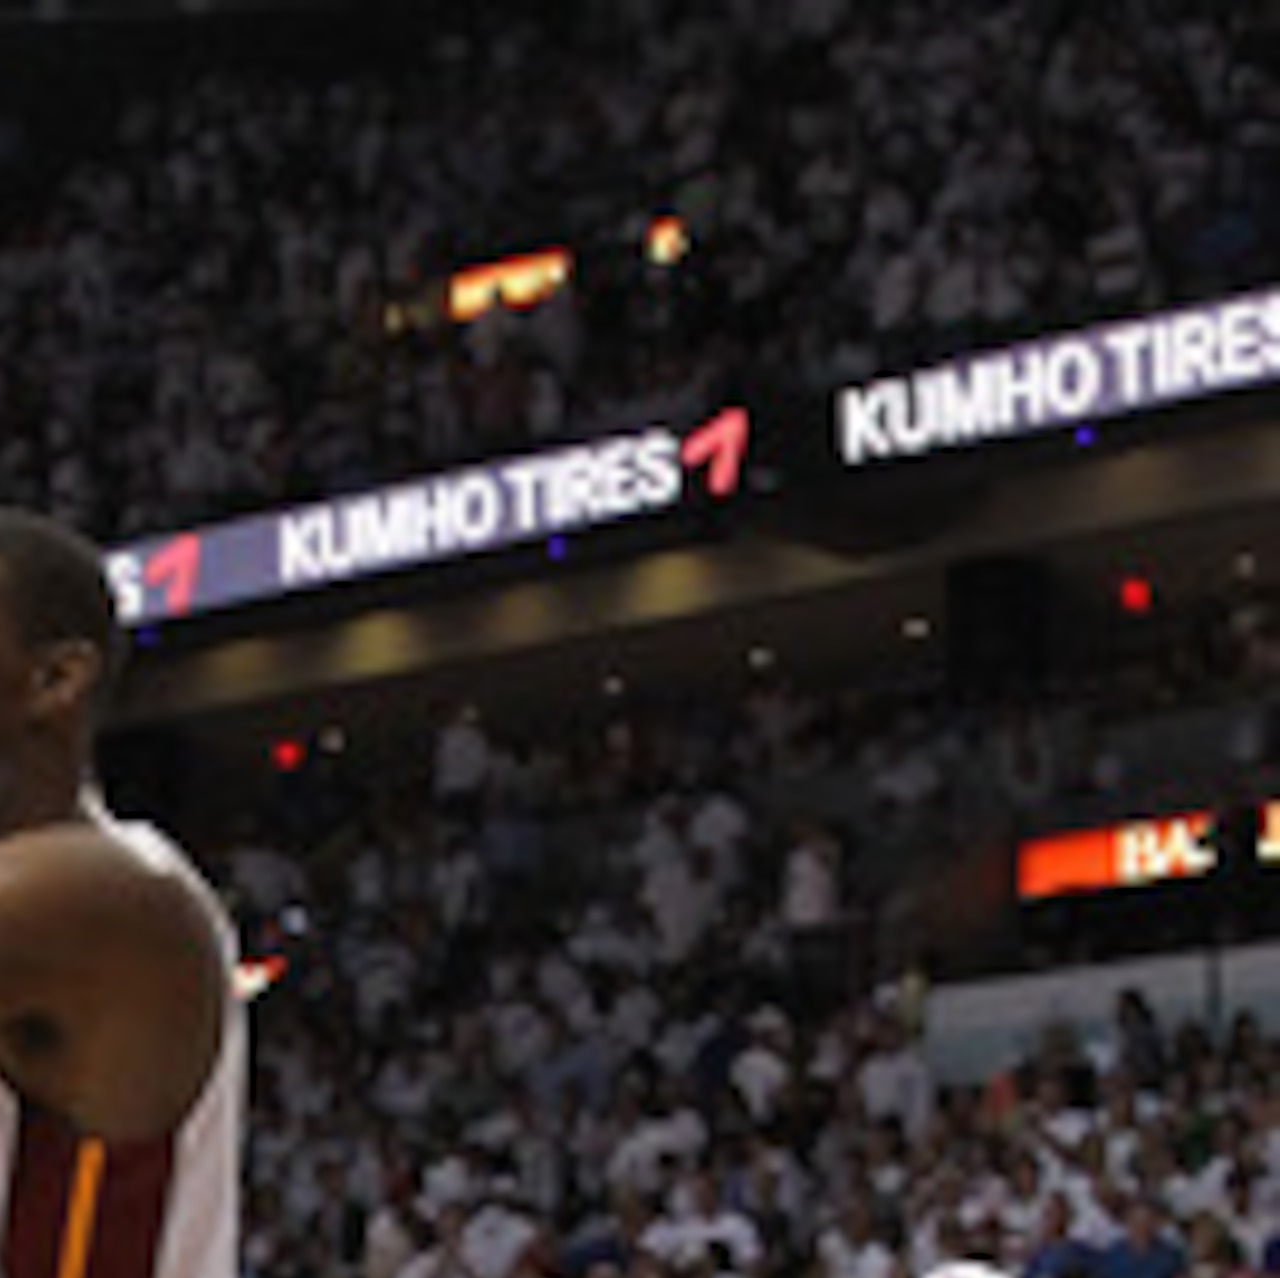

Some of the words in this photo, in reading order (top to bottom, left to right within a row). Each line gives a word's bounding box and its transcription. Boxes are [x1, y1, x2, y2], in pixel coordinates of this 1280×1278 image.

[842, 340, 1101, 465] KUMHO
[279, 473, 499, 584] KUMHO
[503, 429, 682, 532] TIRES
